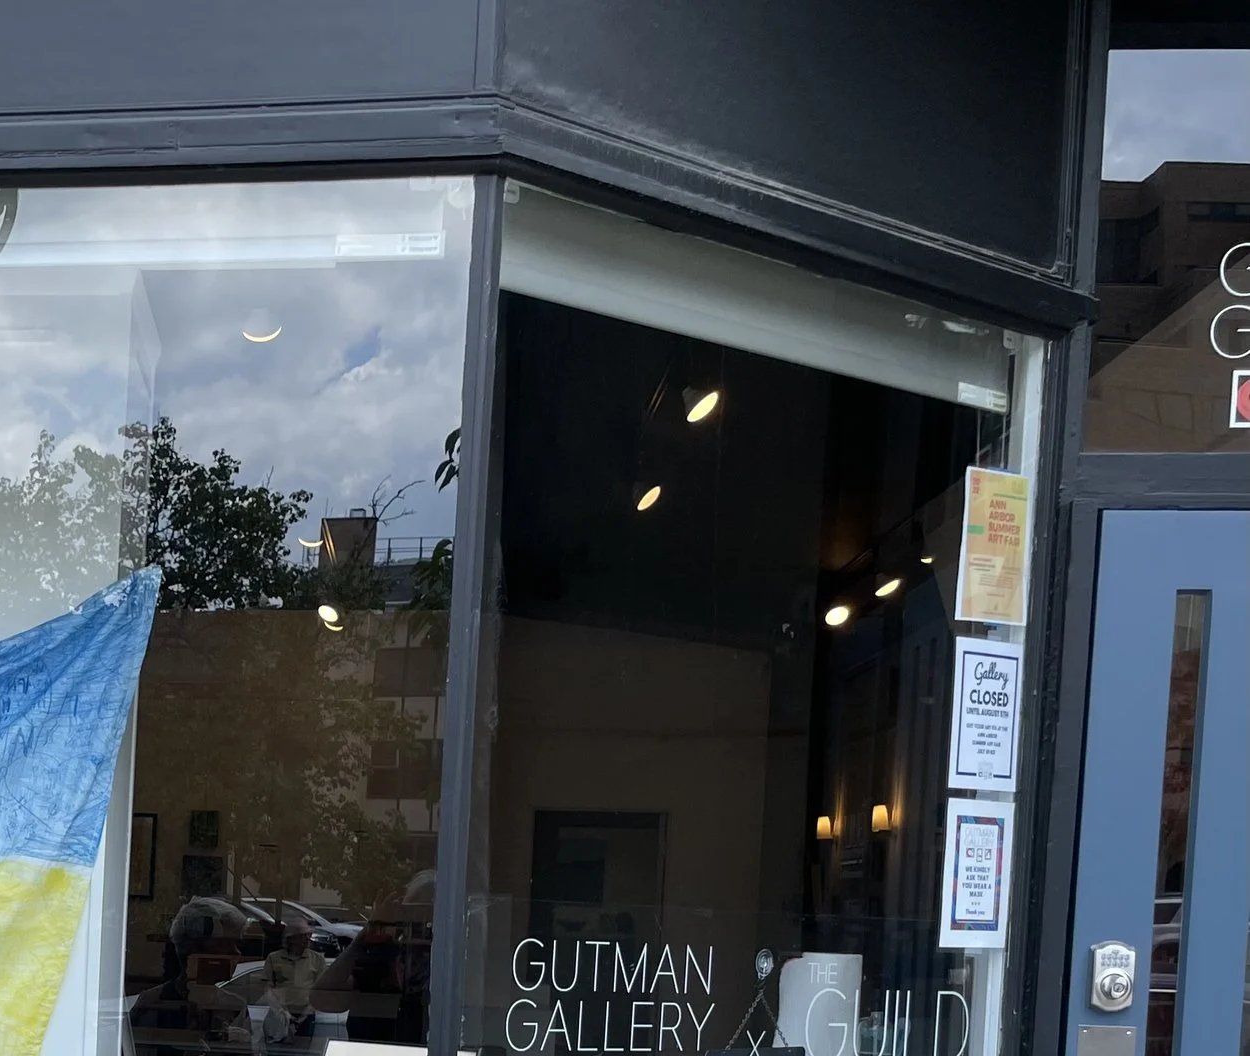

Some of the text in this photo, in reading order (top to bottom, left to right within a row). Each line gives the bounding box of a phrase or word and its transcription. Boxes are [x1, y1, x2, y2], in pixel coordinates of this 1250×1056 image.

[988, 511, 1016, 523] ARBOR
[974, 662, 1008, 690] Gallery
[970, 689, 1009, 708] CLOSED
[512, 938, 713, 995] GUTMAN
[808, 962, 838, 985] THE
[505, 999, 715, 1052] GALLERY
